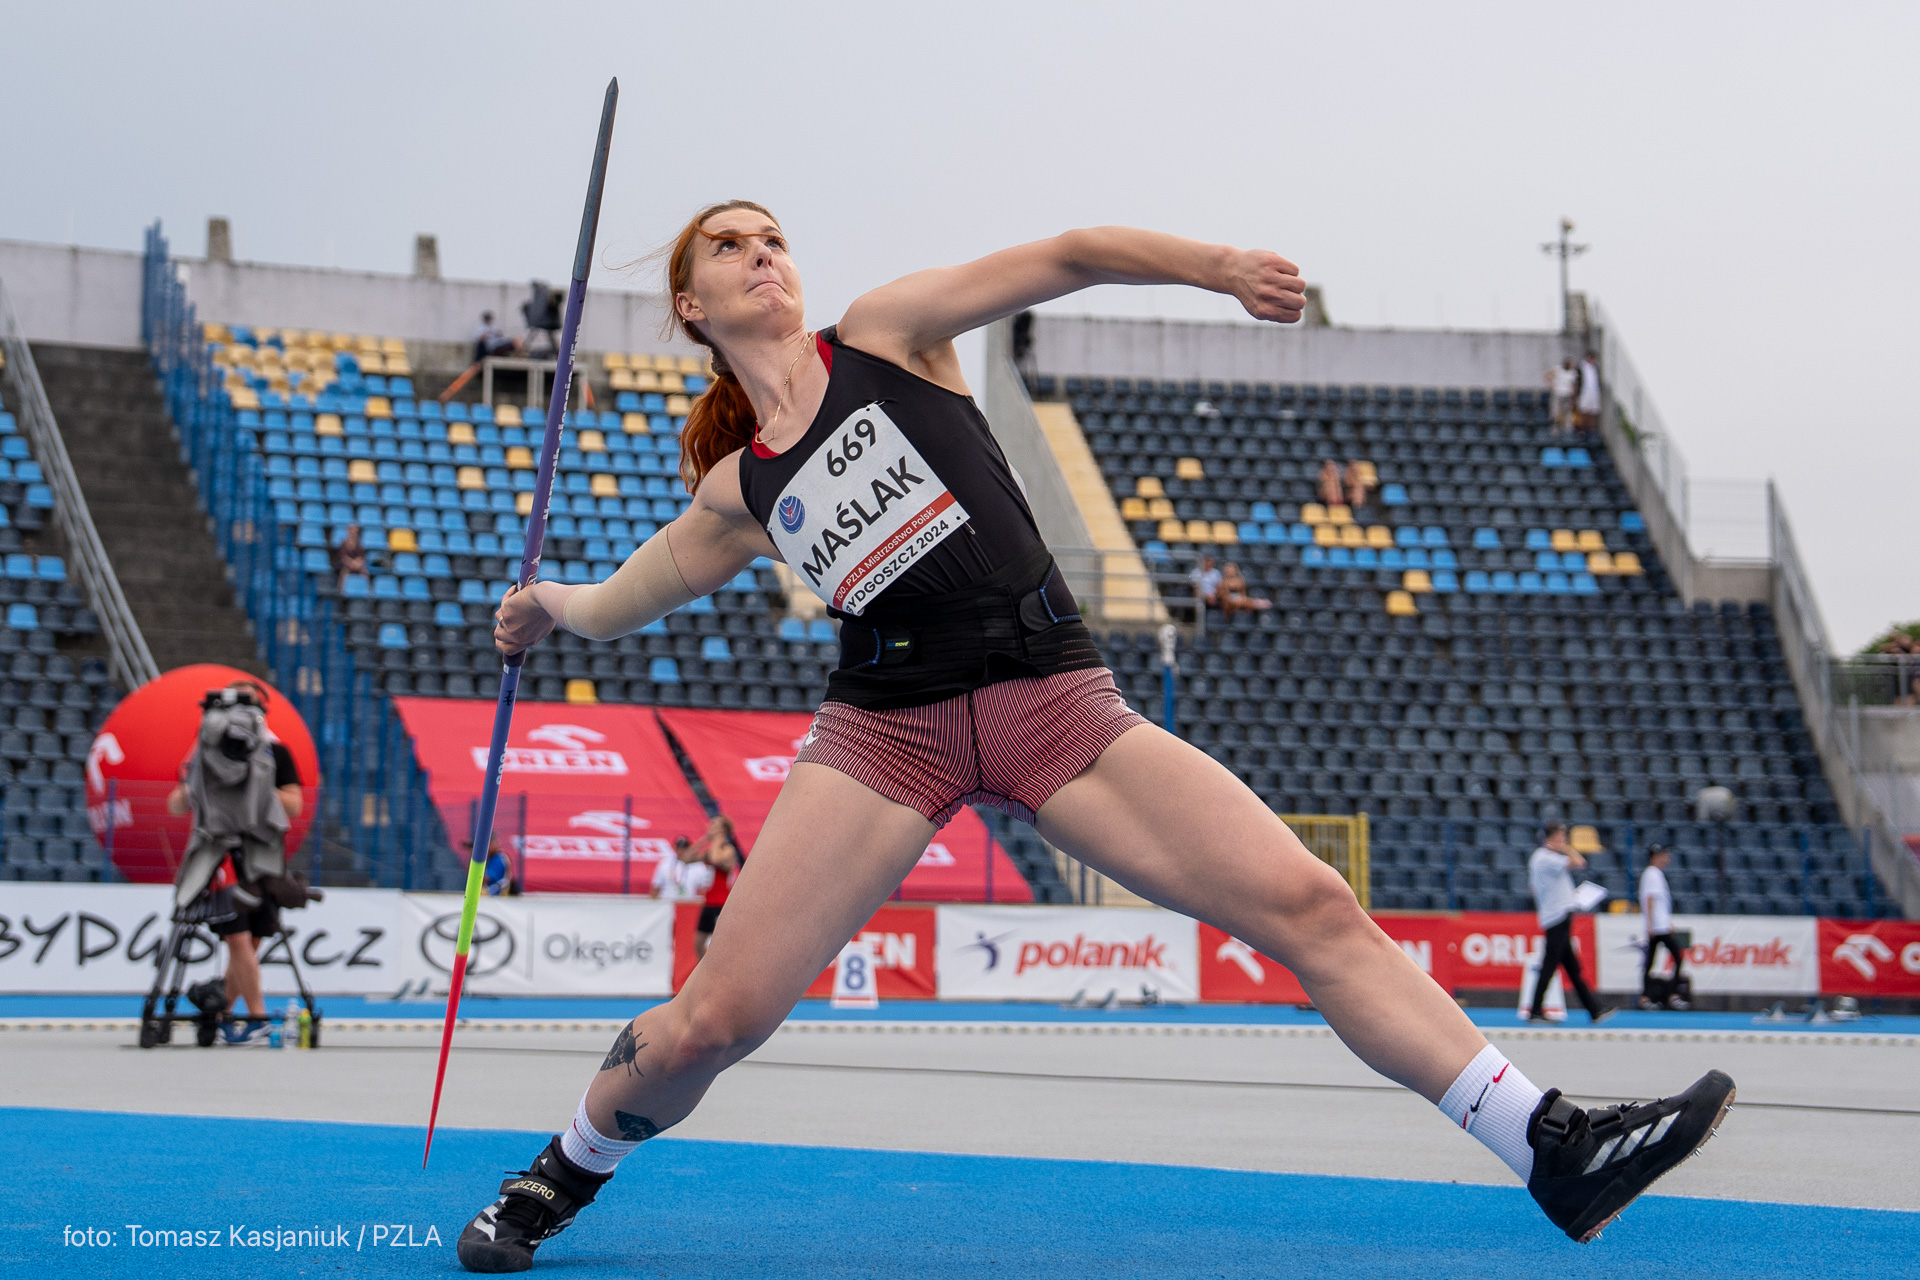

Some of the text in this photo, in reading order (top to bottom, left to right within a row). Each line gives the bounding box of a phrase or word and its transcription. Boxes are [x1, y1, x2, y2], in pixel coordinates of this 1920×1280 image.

[826, 418, 876, 477] 669
[801, 455, 925, 588] MAŚLAK
[915, 519, 950, 549] 2024
[835, 506, 936, 602] 100. PZLA Mistrzostwa Polski
[0, 911, 386, 967] BYDGOZCZ
[543, 932, 653, 971] Okęcie
[1014, 932, 1167, 976] polanik
[844, 953, 868, 991] 8
